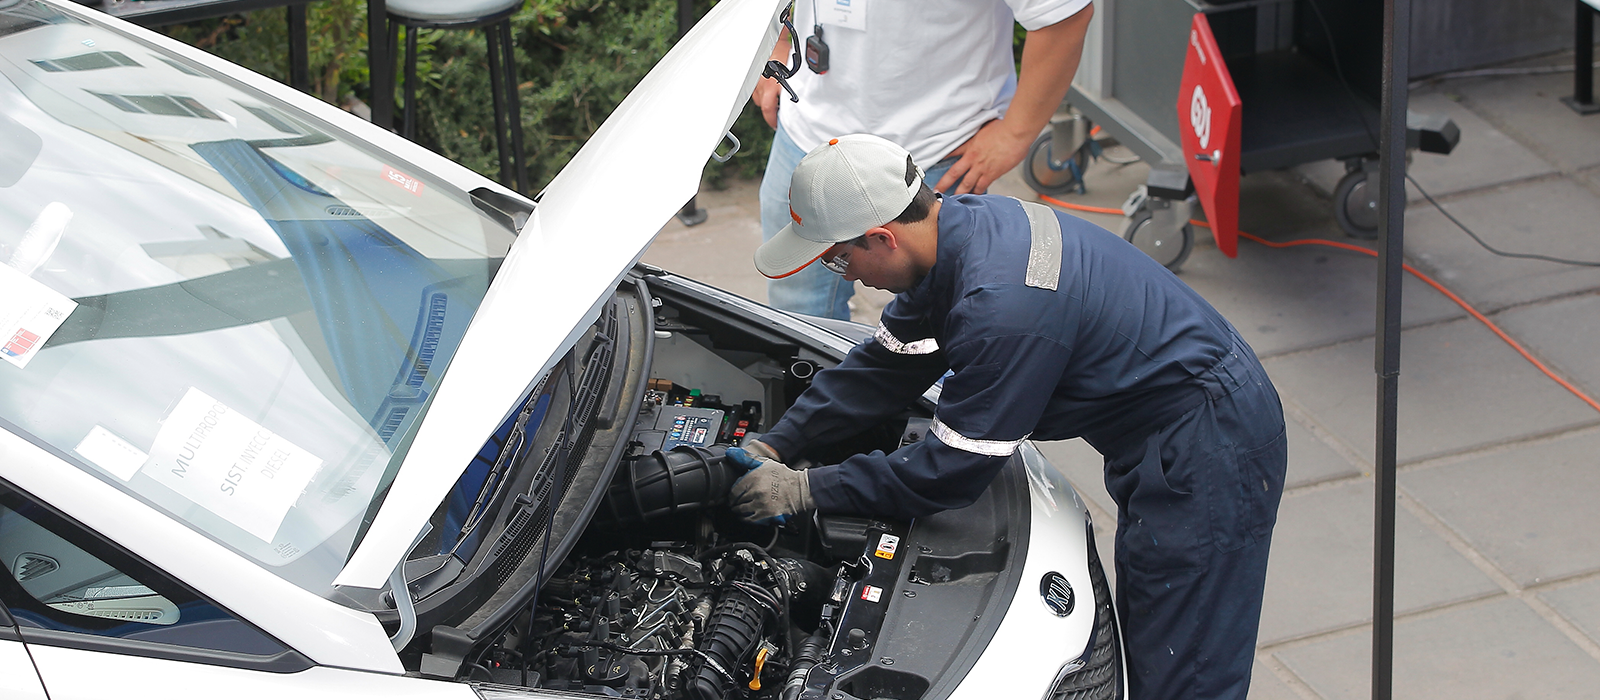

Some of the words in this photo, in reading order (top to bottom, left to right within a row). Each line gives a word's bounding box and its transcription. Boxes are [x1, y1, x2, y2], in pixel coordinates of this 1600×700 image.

[220, 462, 248, 497] SIST.
[239, 426, 275, 465] INYECCI
[260, 448, 291, 480] DIESEL
[1046, 575, 1071, 611] KIA
